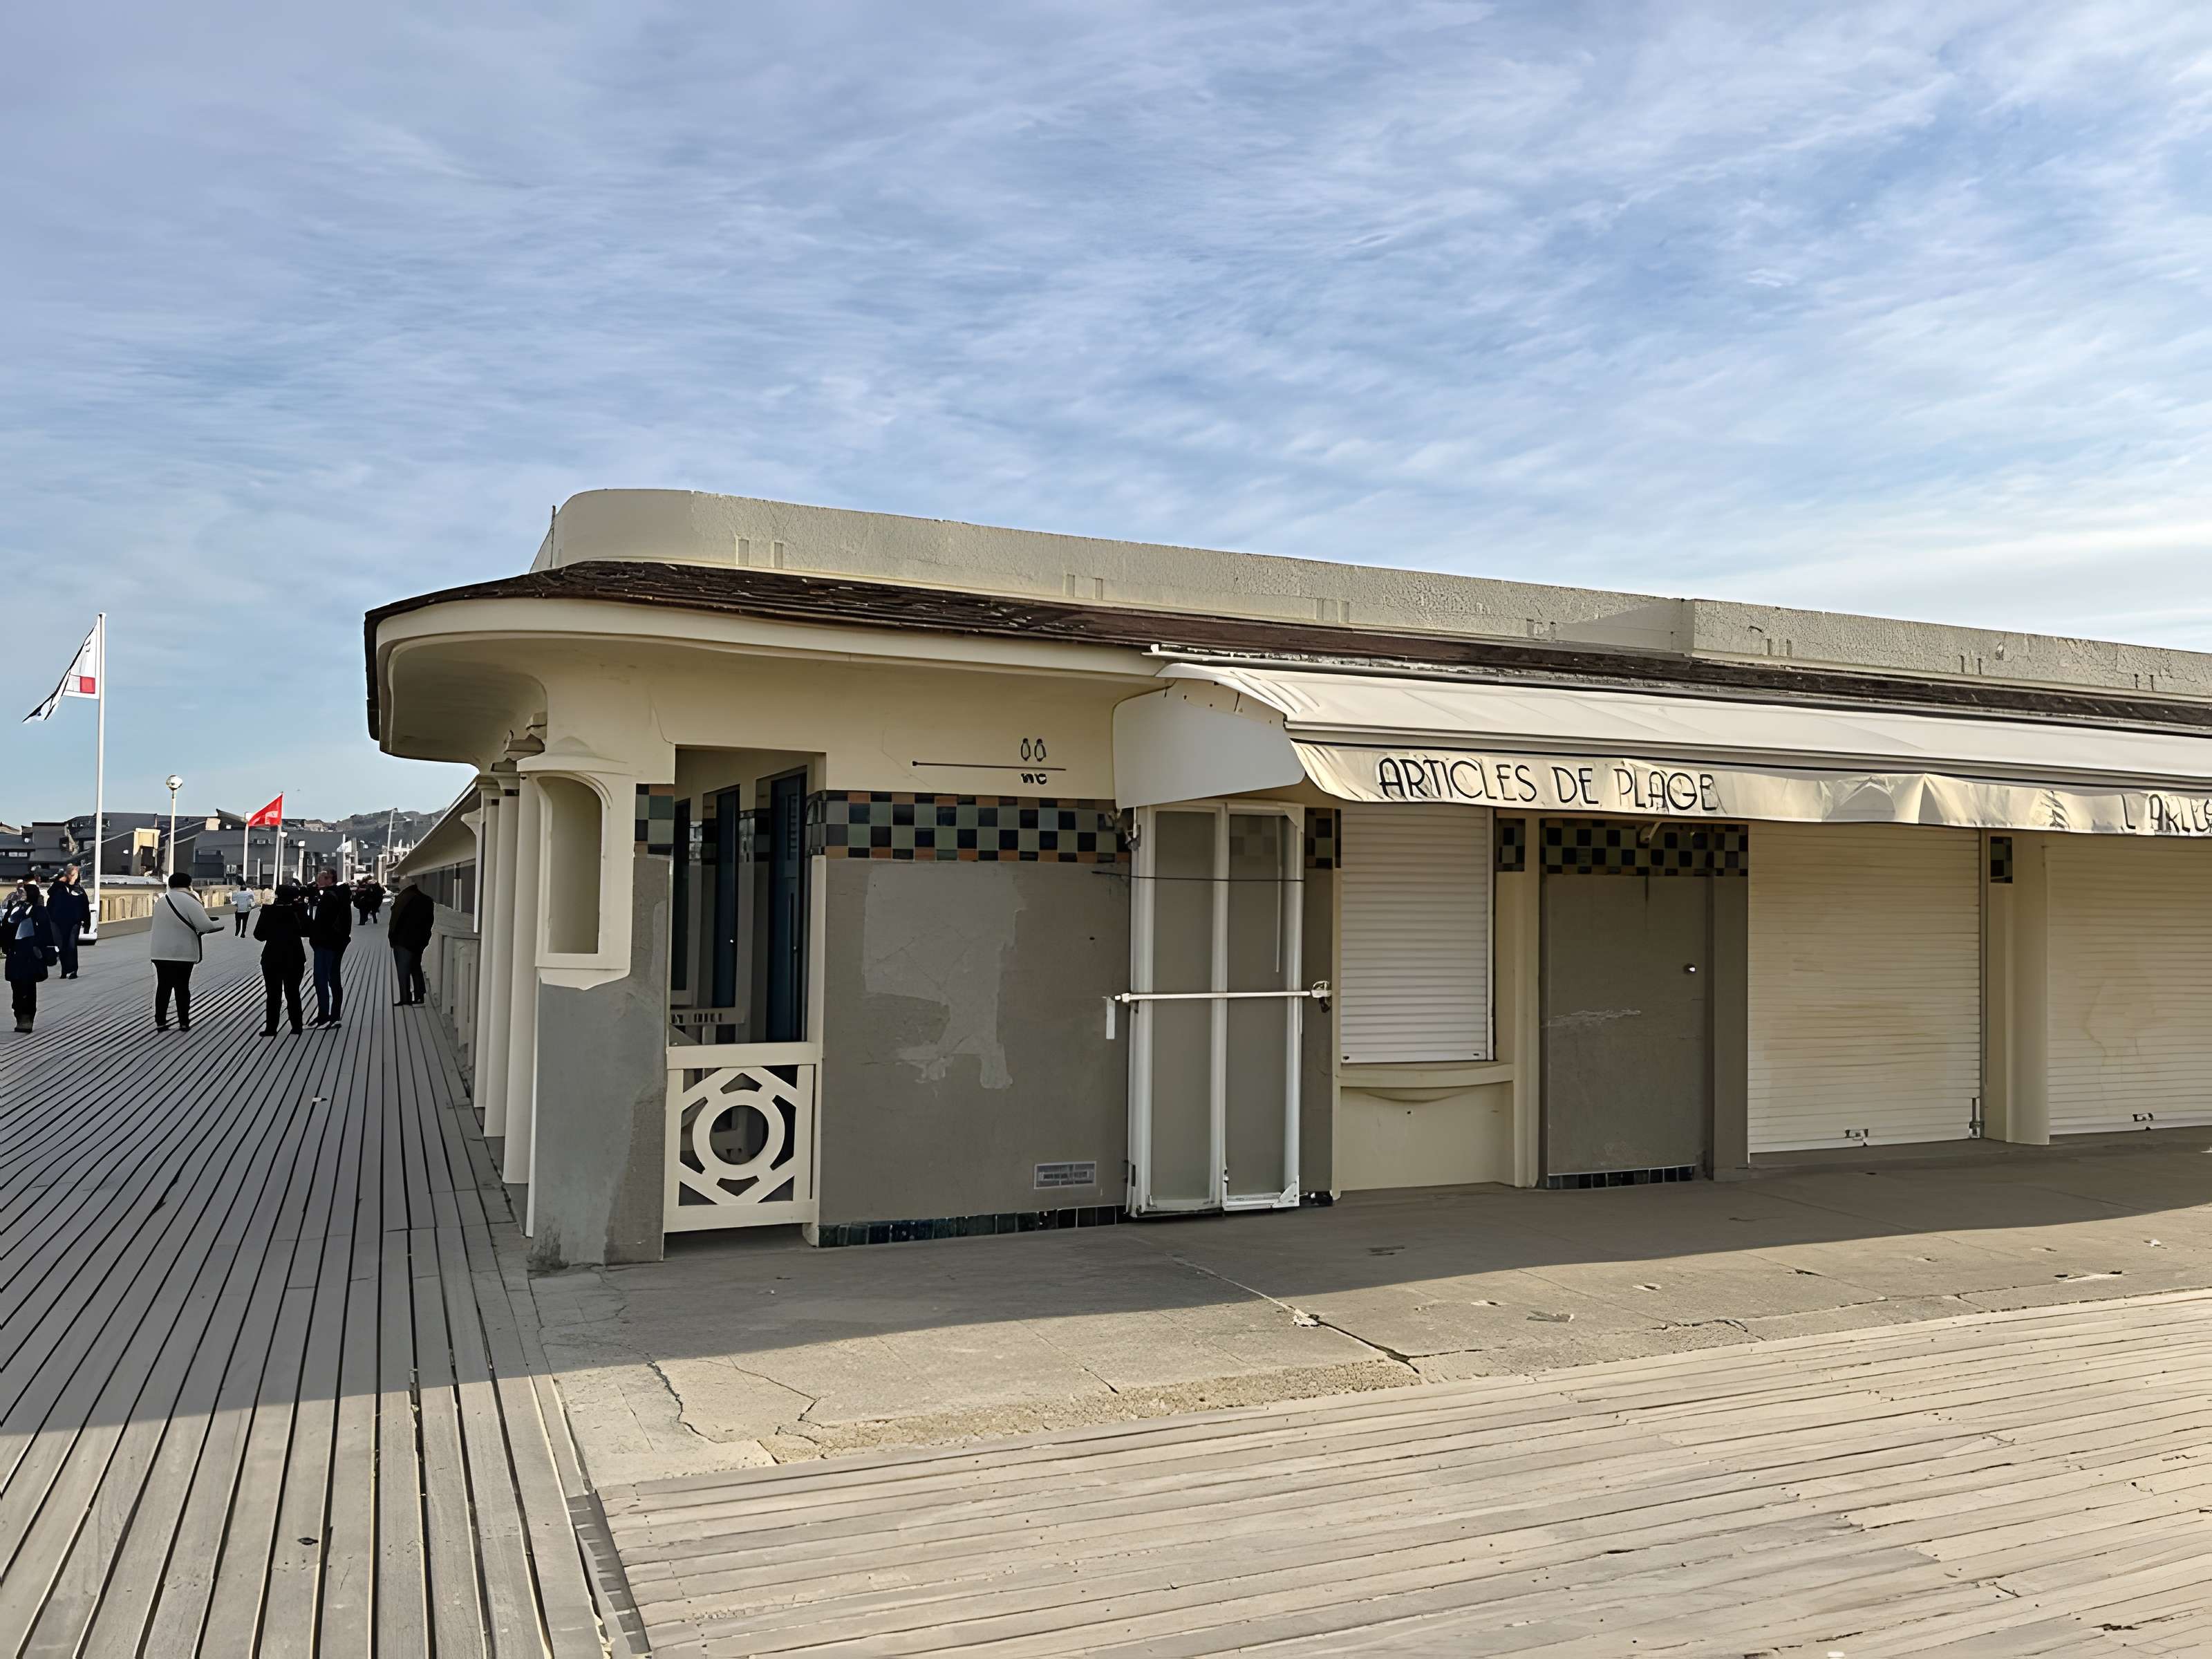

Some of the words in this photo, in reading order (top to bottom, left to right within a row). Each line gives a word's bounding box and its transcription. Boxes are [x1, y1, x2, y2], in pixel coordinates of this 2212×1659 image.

[1379, 757, 1537, 801] ARTICLES
[1552, 767, 1599, 805] DE
[1613, 767, 1717, 812] PLAGE
